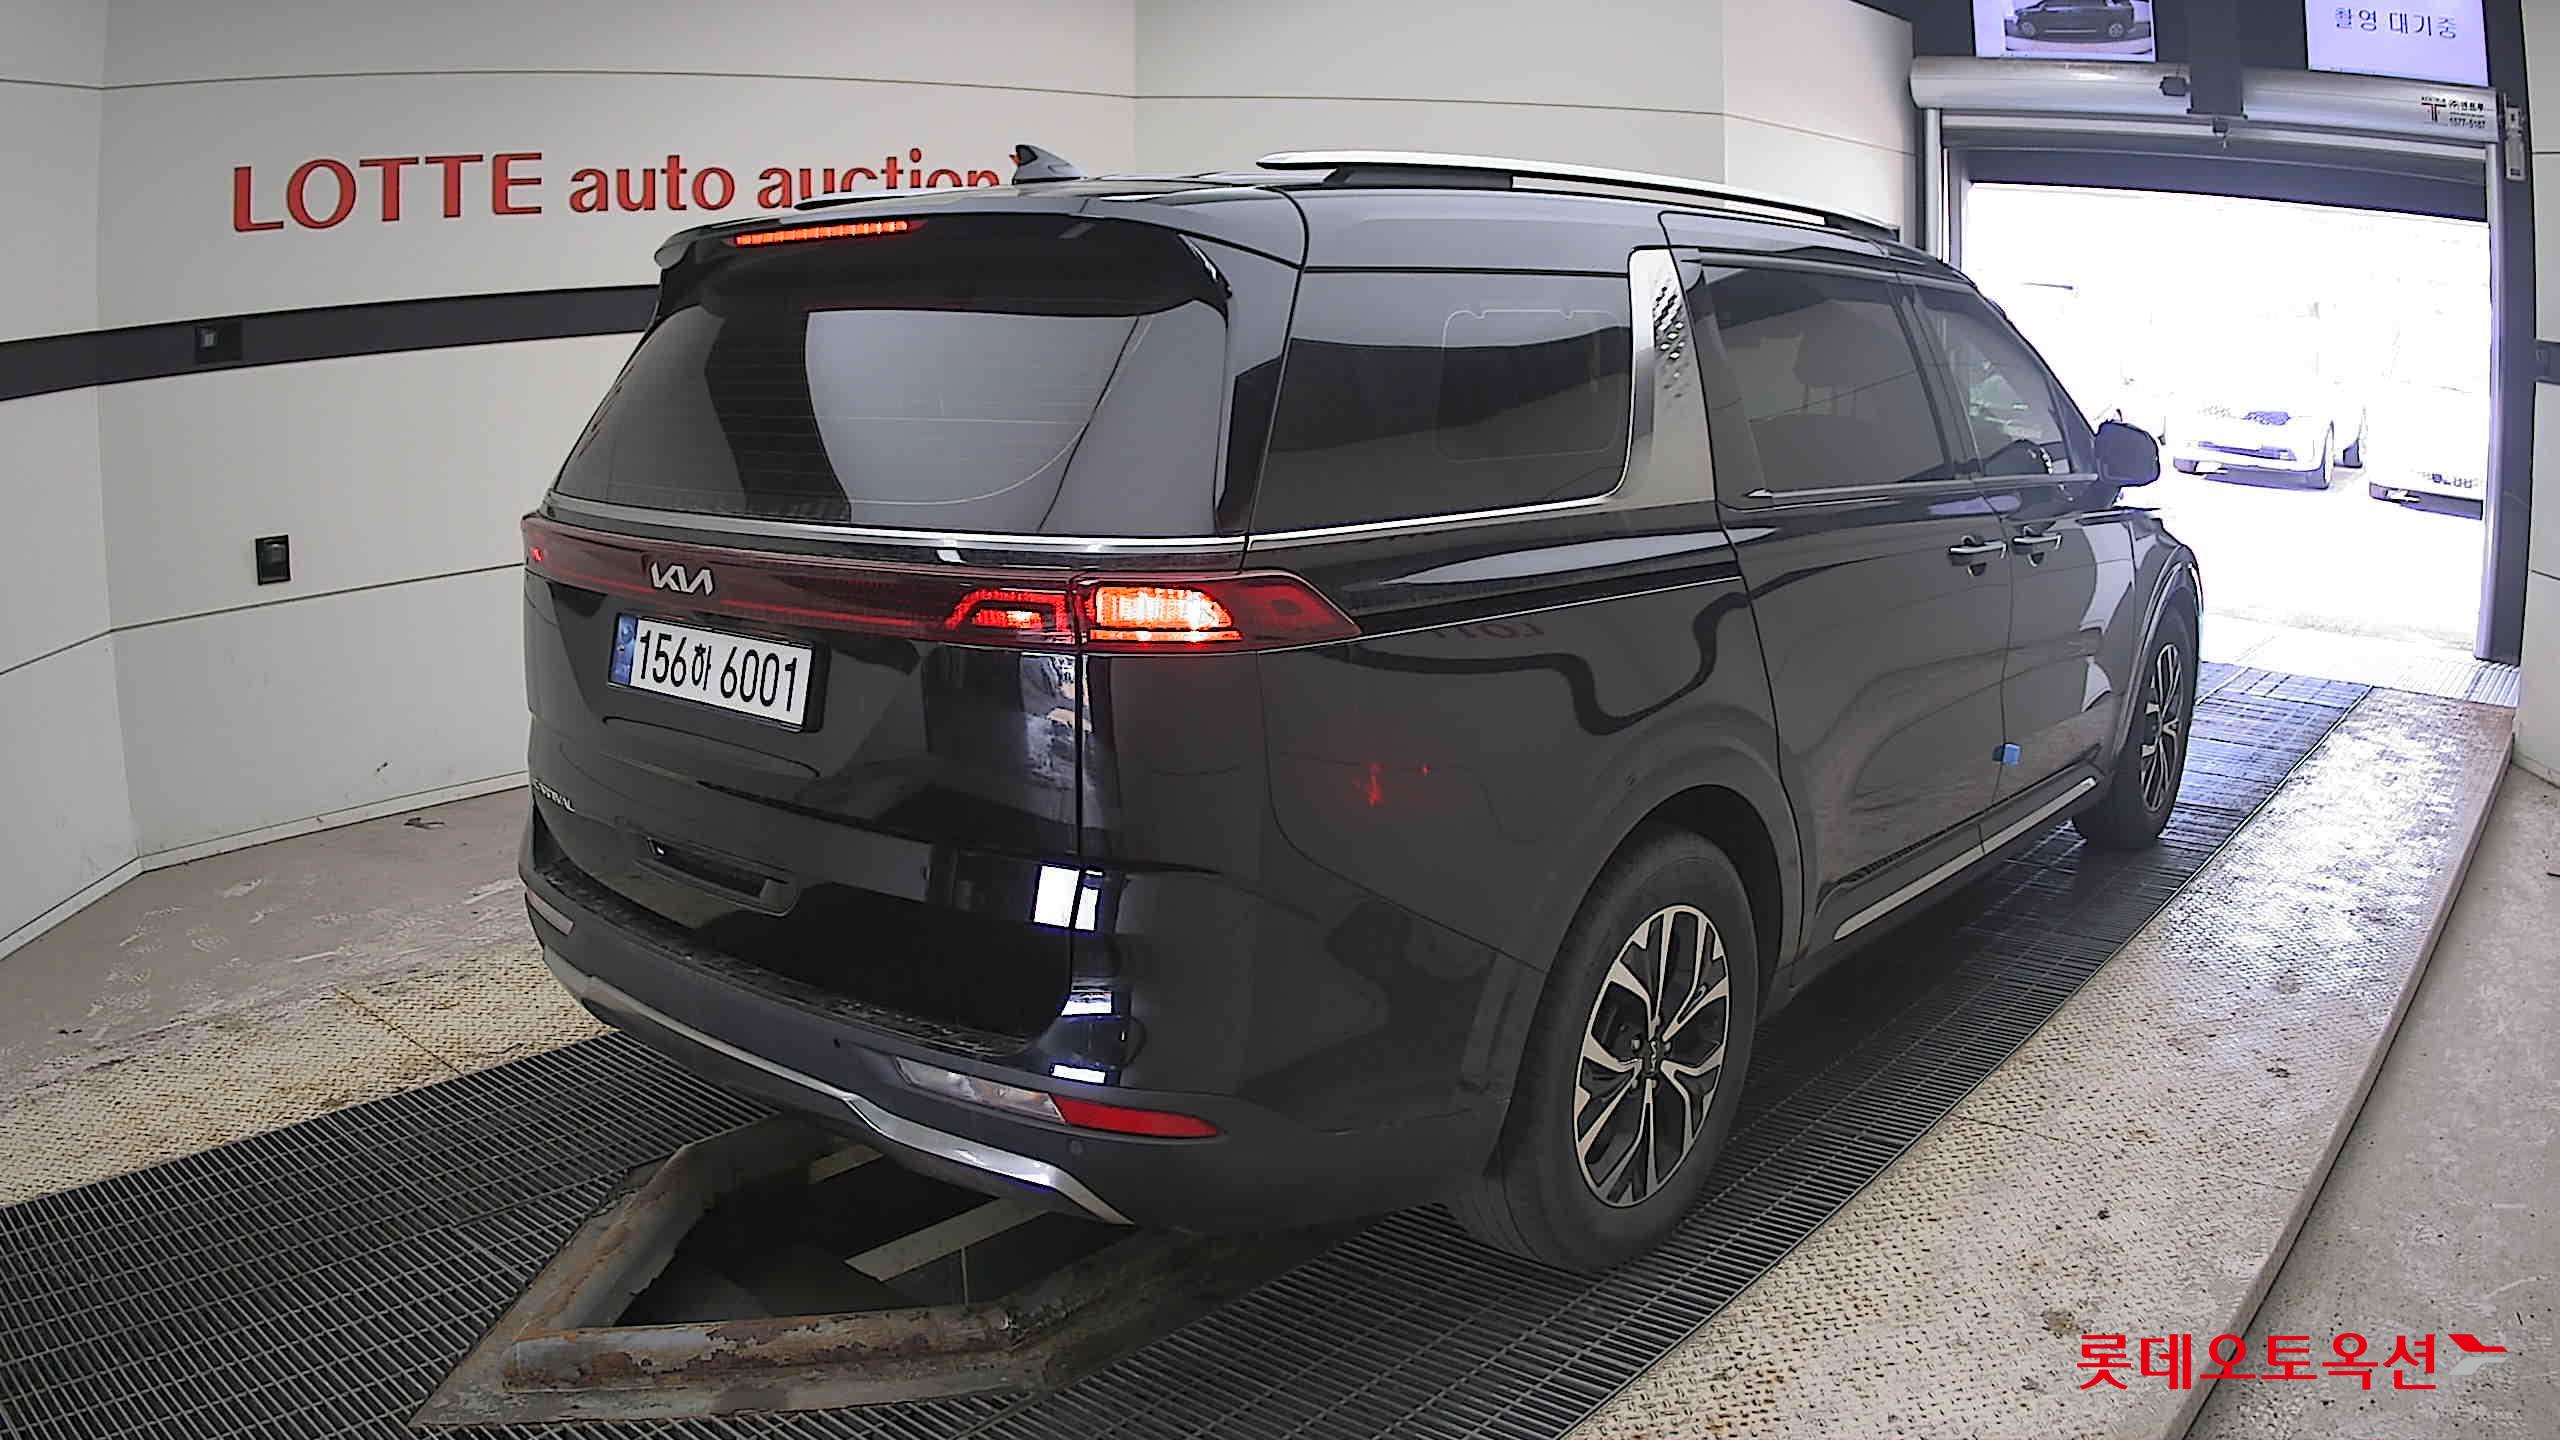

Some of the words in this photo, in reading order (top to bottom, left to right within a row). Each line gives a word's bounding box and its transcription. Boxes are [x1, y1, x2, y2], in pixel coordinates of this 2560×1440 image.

[2388, 12, 2457, 39] 대기중
[233, 152, 543, 233] LOTTE
[568, 154, 736, 213] auto
[650, 561, 715, 597] KIA
[639, 629, 712, 692] 156하
[720, 646, 799, 712] 6001
